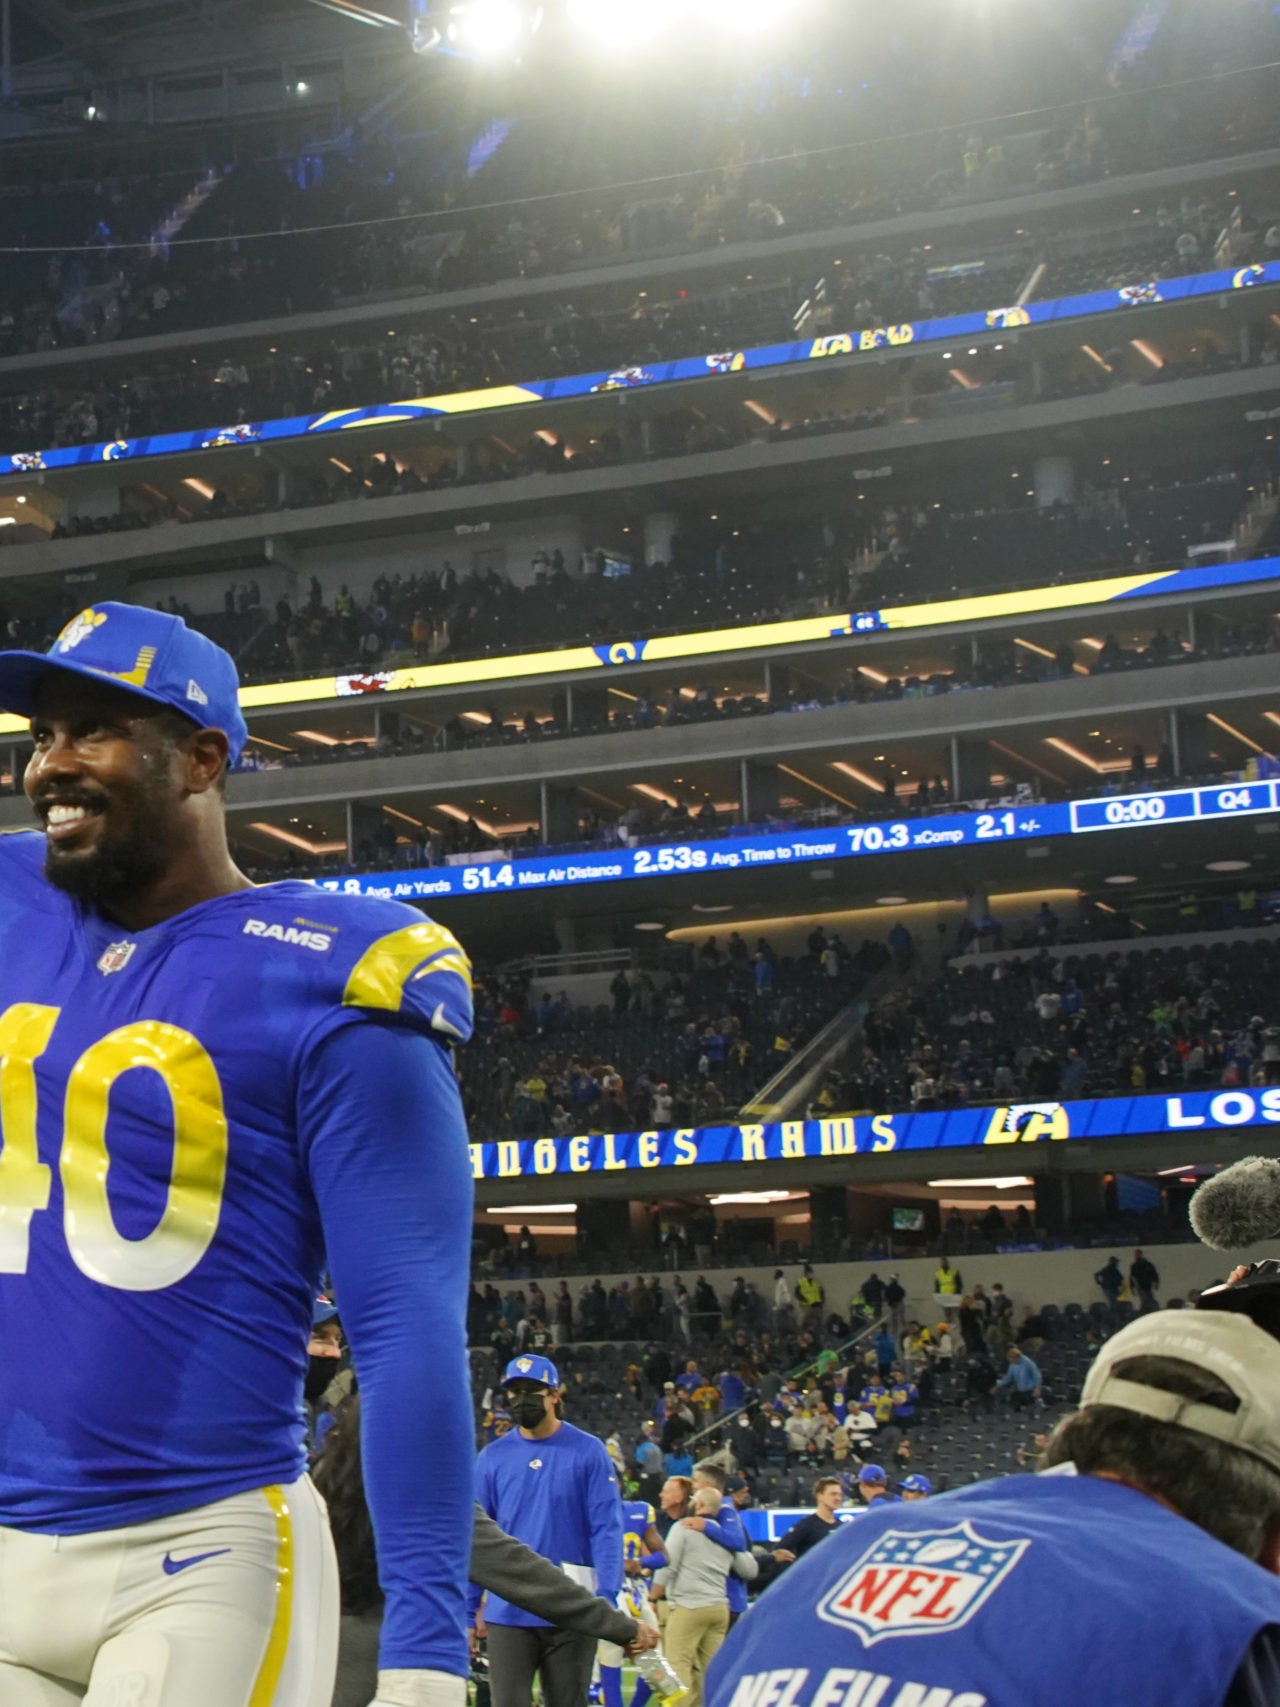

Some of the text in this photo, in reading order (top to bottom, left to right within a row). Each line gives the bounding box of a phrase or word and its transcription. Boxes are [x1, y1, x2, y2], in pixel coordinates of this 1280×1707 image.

[1105, 798, 1166, 823] 0:00
[1217, 789, 1252, 810] Q4
[395, 884, 413, 896] Air
[414, 880, 451, 894] Yards
[462, 865, 514, 890] 51.4
[519, 872, 545, 884] Max
[547, 869, 566, 882] Air
[567, 864, 622, 881] Distance
[634, 847, 708, 873] 2.53s
[711, 853, 741, 867] Avg.
[743, 847, 776, 862] Time
[777, 847, 791, 858] to
[792, 843, 837, 857] Throw
[847, 824, 909, 851] 70.3
[914, 830, 964, 844] xComp
[976, 812, 1016, 838] 2.1
[243, 919, 331, 951] RAMS
[740, 1115, 897, 1162] RAMS
[839, 1568, 962, 1622] NFL
[728, 1668, 809, 1707] NFL
